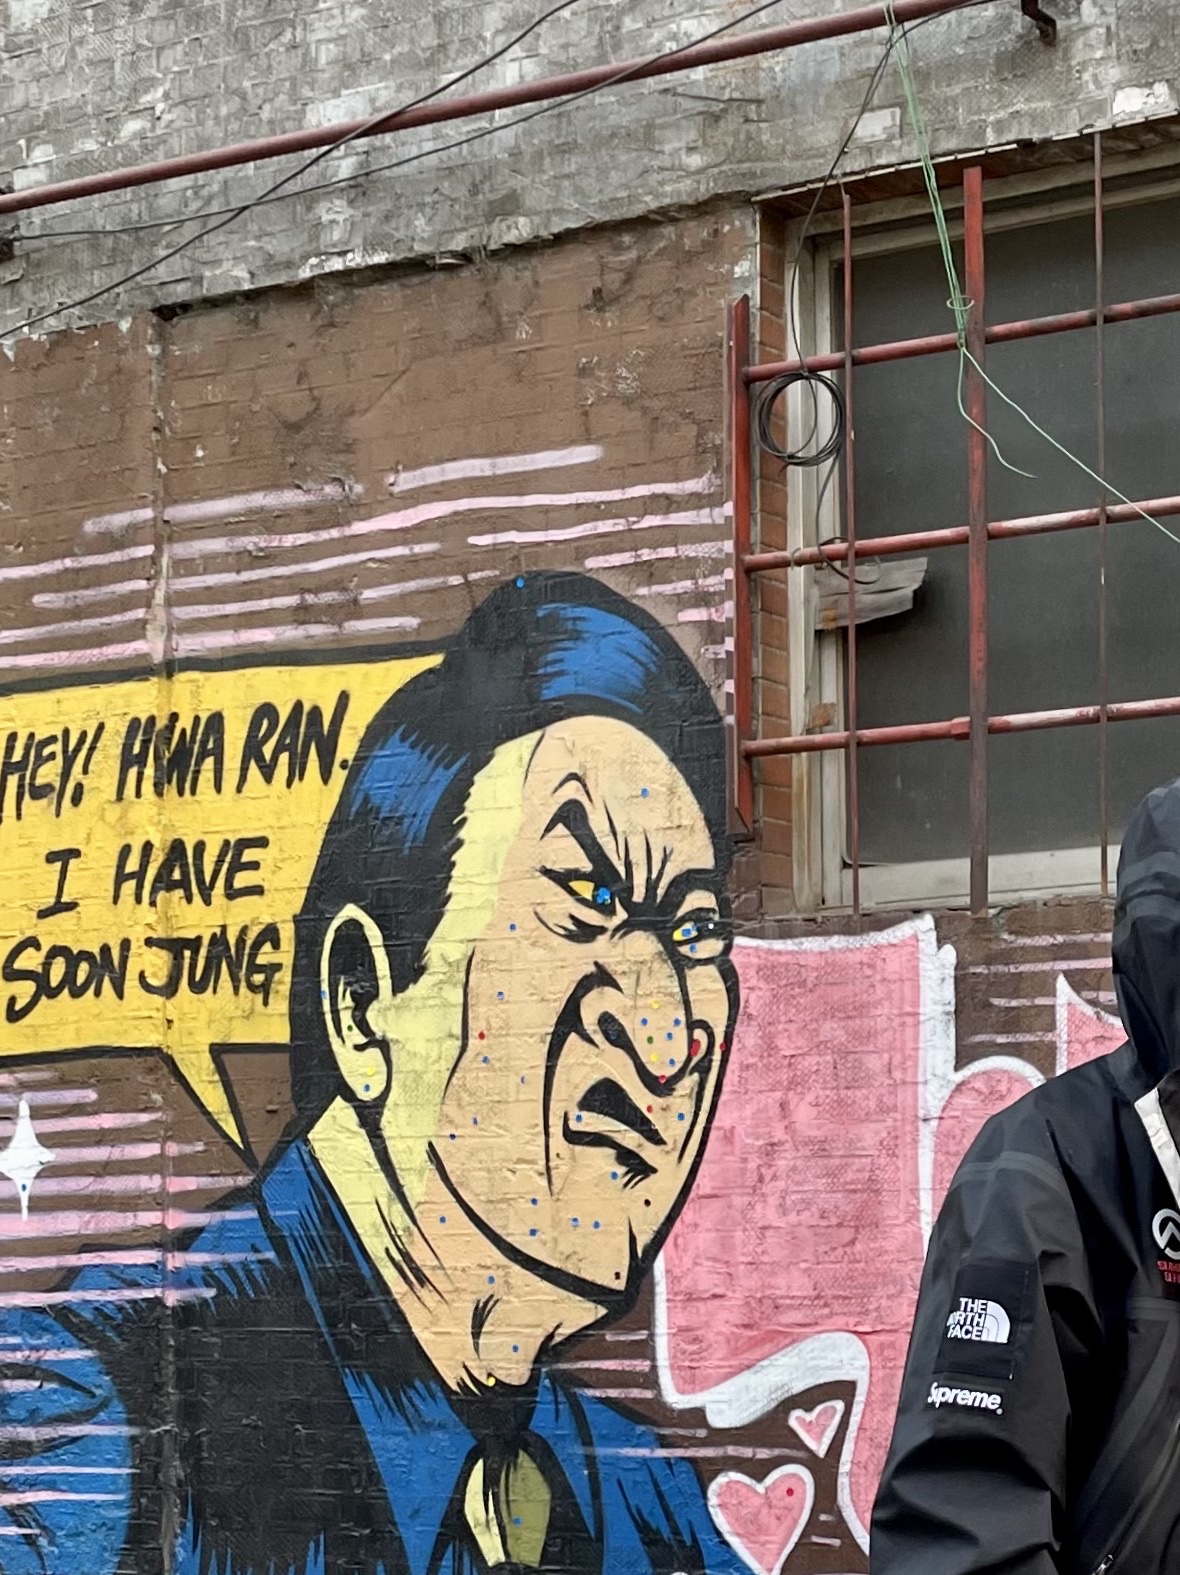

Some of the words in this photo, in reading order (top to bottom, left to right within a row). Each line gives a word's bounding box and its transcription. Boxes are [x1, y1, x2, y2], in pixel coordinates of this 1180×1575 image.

[0, 722, 105, 824] HEY!
[116, 711, 225, 801] HWA
[236, 690, 350, 794] RAN.
[37, 848, 82, 919] I
[113, 836, 270, 906] HAVE
[2, 930, 131, 1024] SOON
[139, 924, 283, 1007] JUNG
[947, 1325, 983, 1340] FACE
[959, 1297, 988, 1313] THE
[927, 1382, 1002, 1410] Spreme
